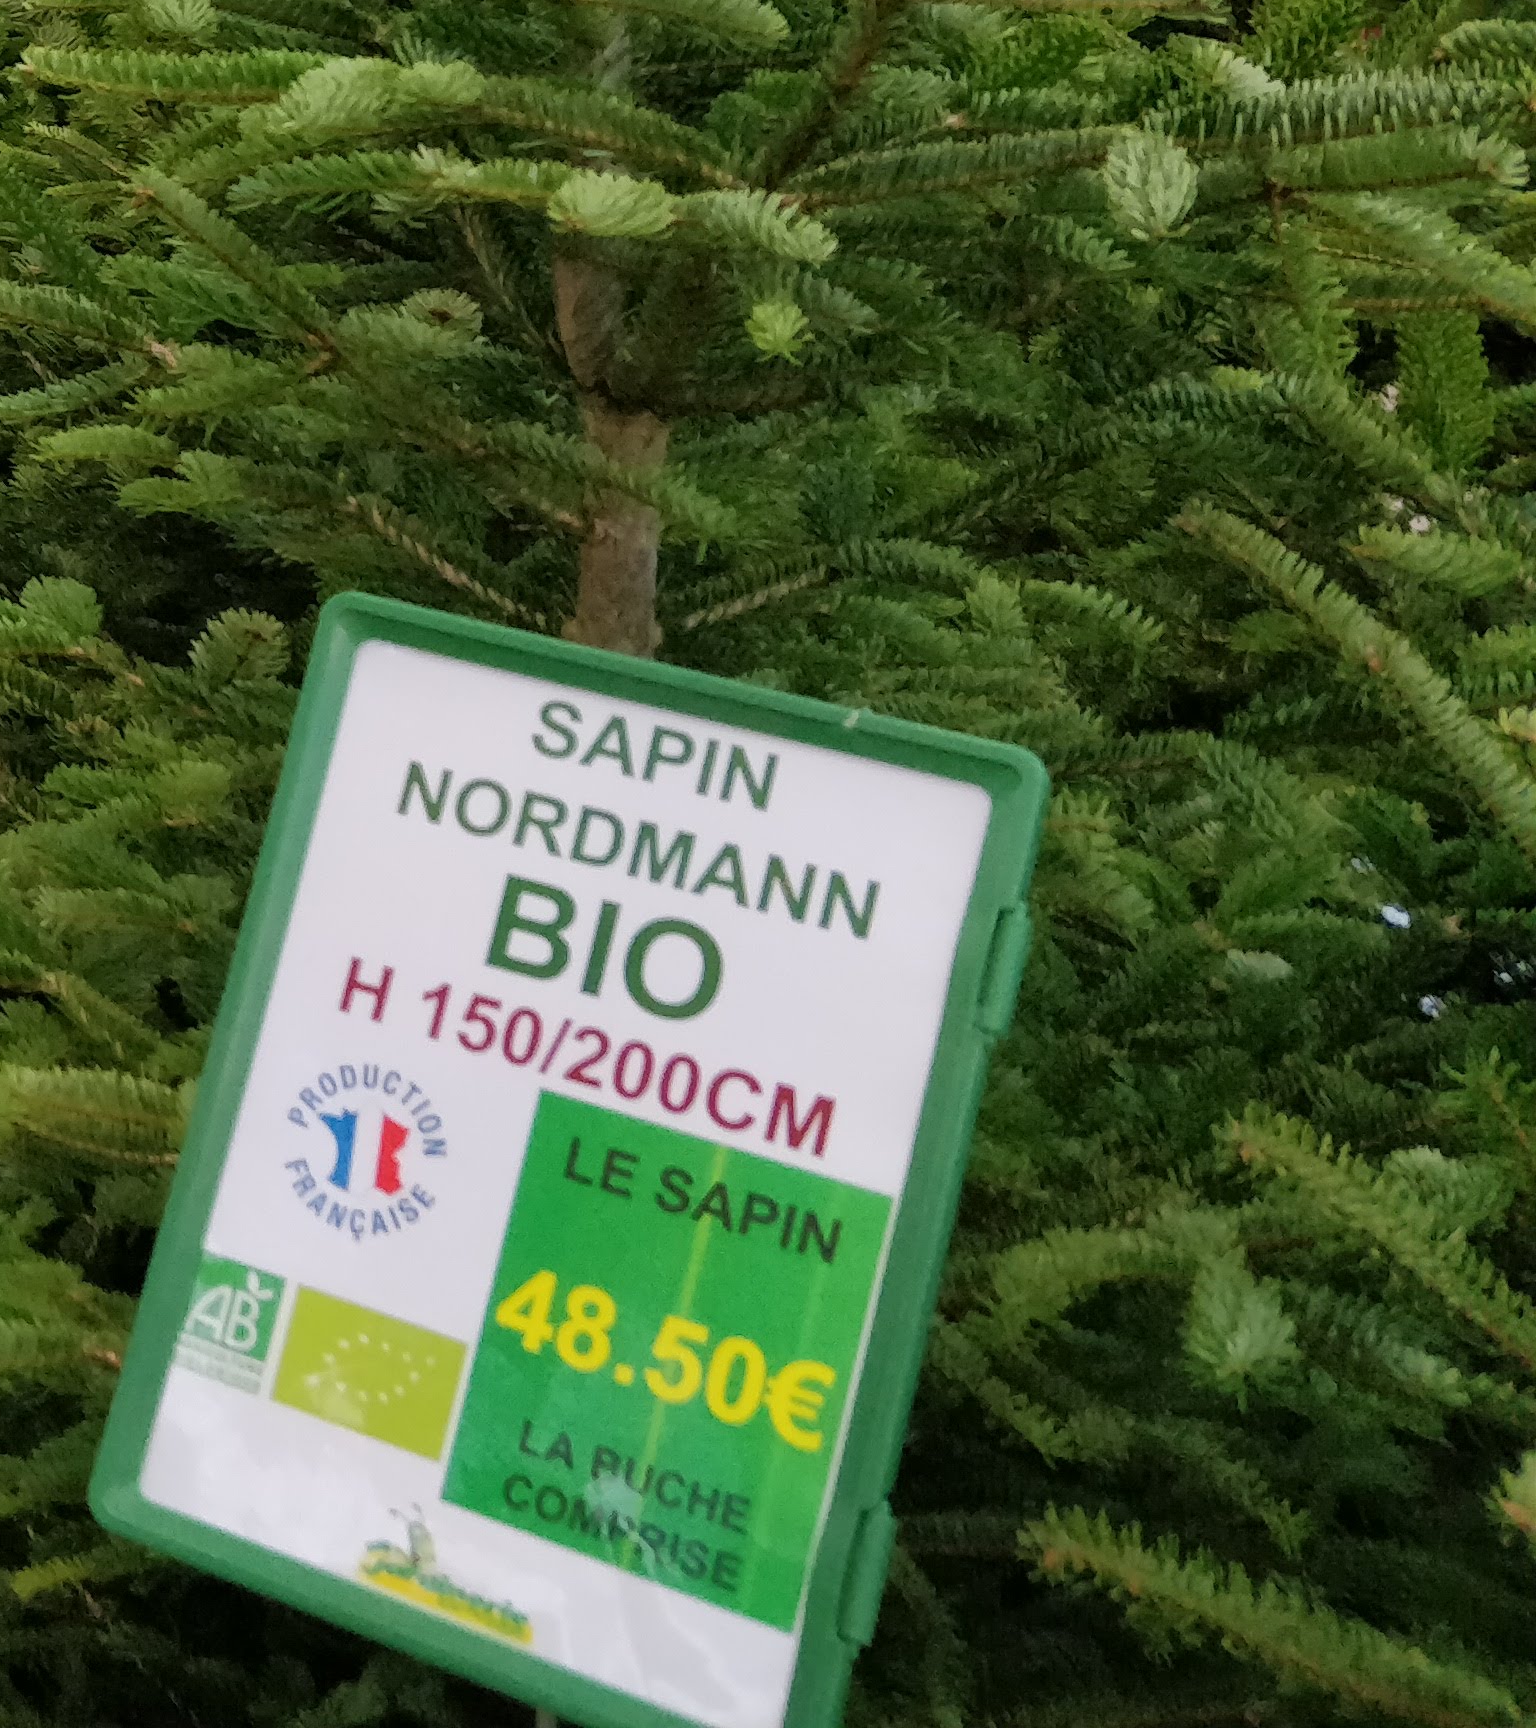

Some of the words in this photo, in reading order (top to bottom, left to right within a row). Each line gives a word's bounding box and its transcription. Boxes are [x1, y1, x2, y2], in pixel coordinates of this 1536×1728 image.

[532, 700, 778, 812] SAPIN
[397, 761, 880, 939] NORDMANN
[485, 873, 724, 1021] BIO
[287, 1064, 447, 1157] PRODUCTION
[339, 956, 395, 1023] H
[423, 982, 836, 1158] 150/200CM
[284, 1158, 436, 1242] FRANÇAISE
[563, 1137, 640, 1199] LE
[655, 1164, 842, 1264] SAPIN
[184, 1283, 261, 1352] AB
[495, 1269, 836, 1452] 48.50€
[519, 1418, 574, 1470] LA
[502, 1474, 741, 1594] COMPRISE
